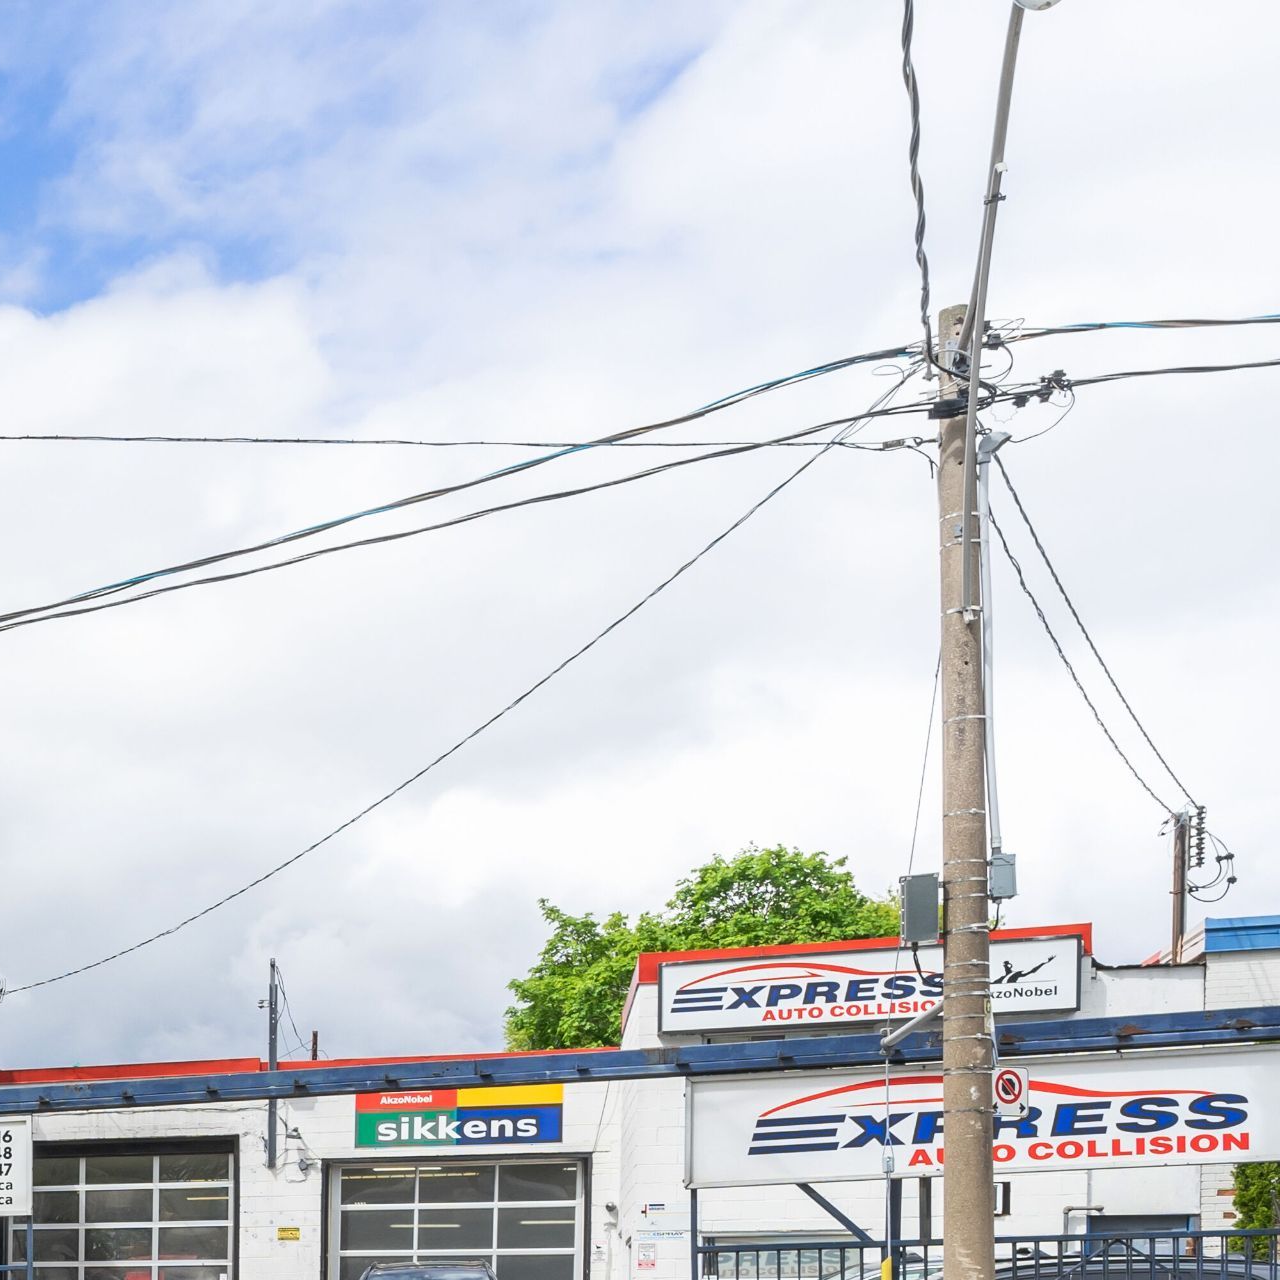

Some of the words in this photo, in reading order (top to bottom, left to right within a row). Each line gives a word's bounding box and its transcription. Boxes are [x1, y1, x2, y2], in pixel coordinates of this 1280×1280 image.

[670, 973, 944, 1014] EXPRESS
[990, 985, 1058, 999] zoNobel
[761, 1006, 823, 1022] AUTO
[830, 1000, 936, 1018] COLLISIO
[380, 1094, 432, 1105] AkzoNobel
[377, 1115, 538, 1142] sikkens
[908, 1143, 1016, 1167] AO
[1028, 1132, 1250, 1161] COLLISION
